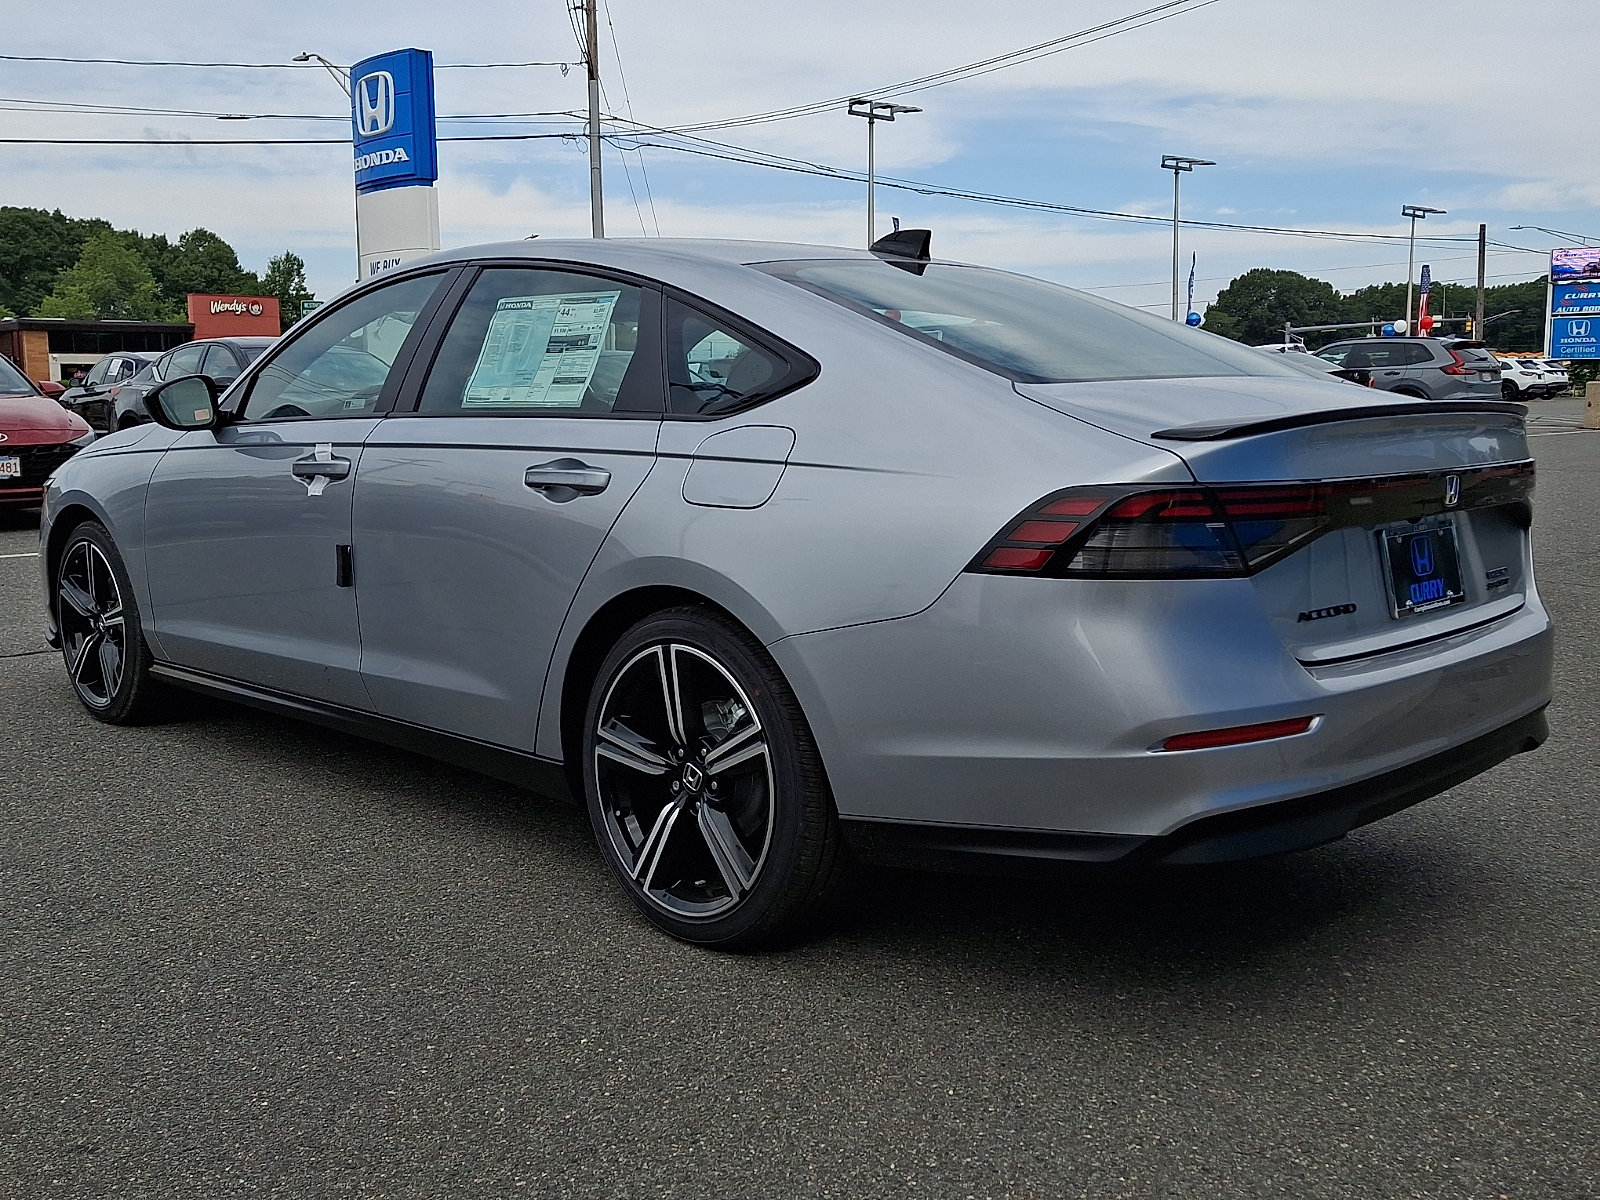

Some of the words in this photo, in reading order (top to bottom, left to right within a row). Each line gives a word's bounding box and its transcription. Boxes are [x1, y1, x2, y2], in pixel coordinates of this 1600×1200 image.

[354, 147, 410, 171] HONDA
[210, 298, 248, 315] Wendy's
[560, 308, 571, 317] 44
[1410, 577, 1445, 603] CURRY
[1297, 603, 1357, 623] ACCORD
